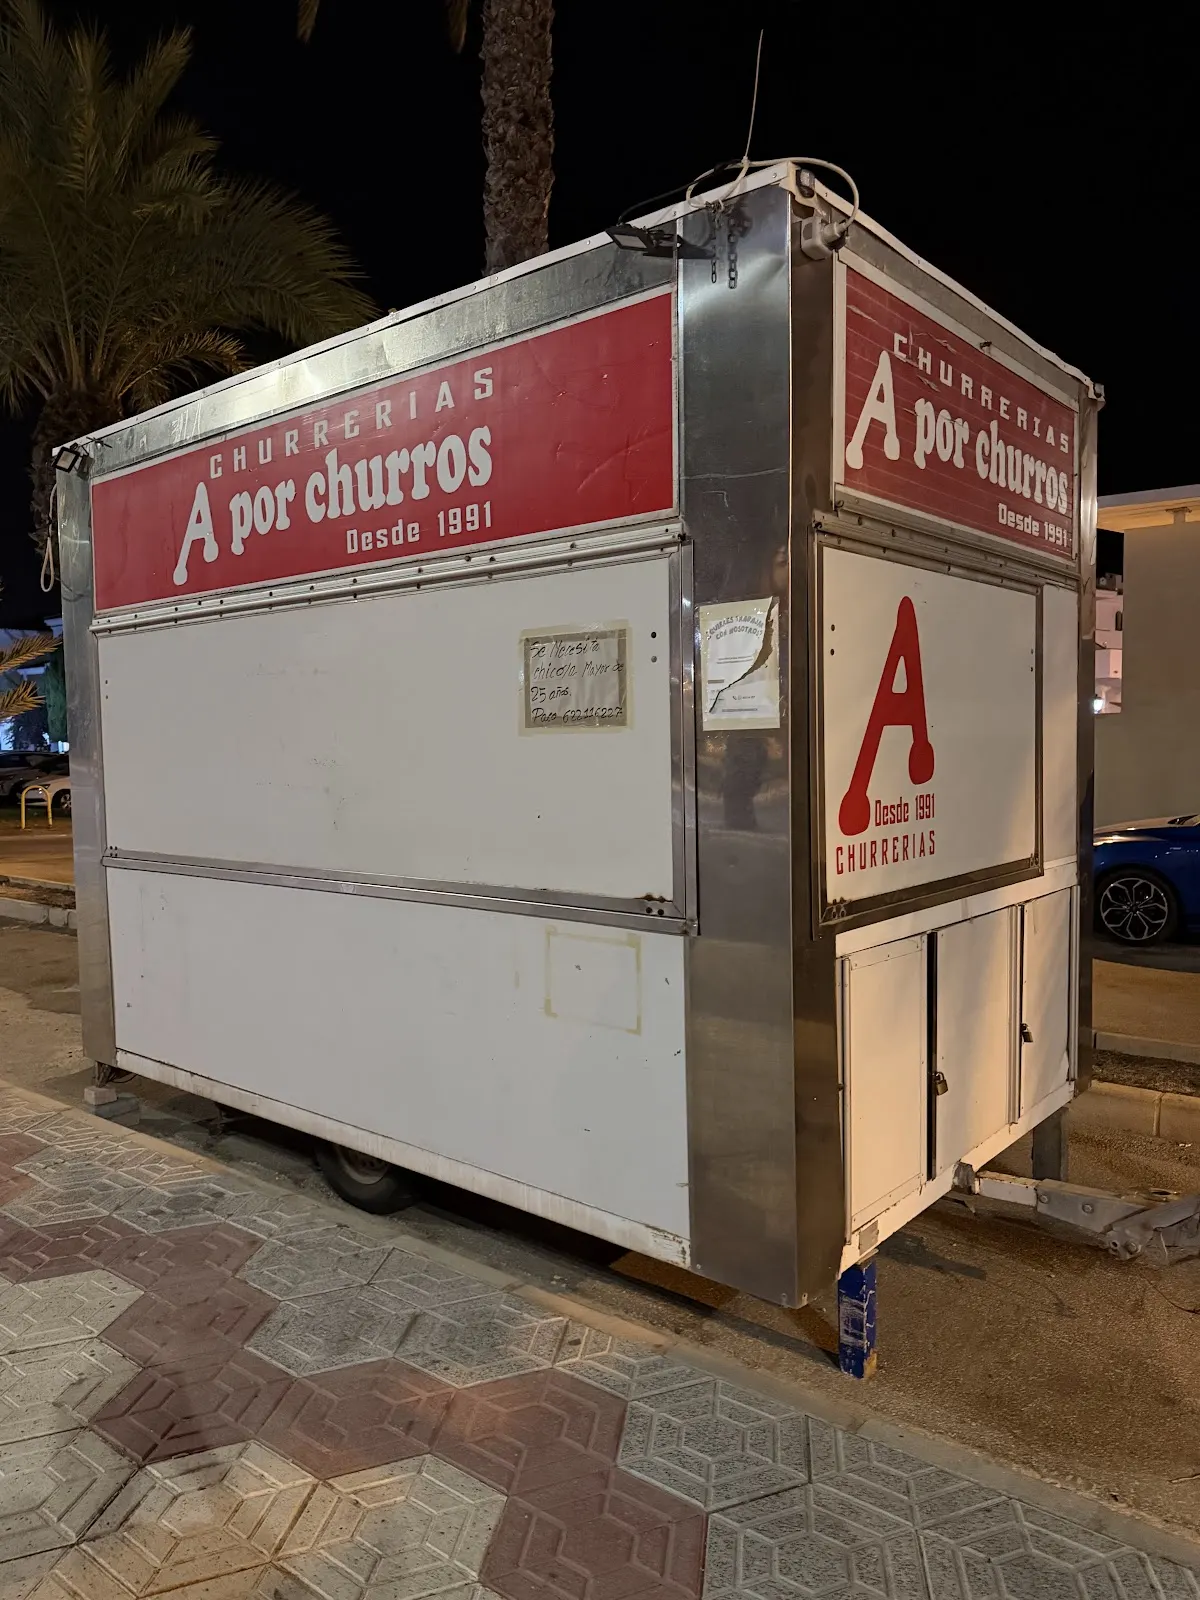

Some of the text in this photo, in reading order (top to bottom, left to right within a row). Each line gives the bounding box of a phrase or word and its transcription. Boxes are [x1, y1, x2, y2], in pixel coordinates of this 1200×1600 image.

[894, 332, 1069, 453] CHURRERIAS
[210, 367, 493, 479] CHURRERIAS
[845, 350, 1068, 515] A por churros
[173, 425, 493, 586] A por churros
[347, 501, 493, 554] Desde 1991
[998, 502, 1068, 548] Desde 1991
[530, 641, 546, 658] Se
[530, 686, 546, 703] 25
[838, 596, 935, 836] A
[874, 793, 936, 827] Desde 1991
[836, 830, 936, 875] CHURRERIAS
